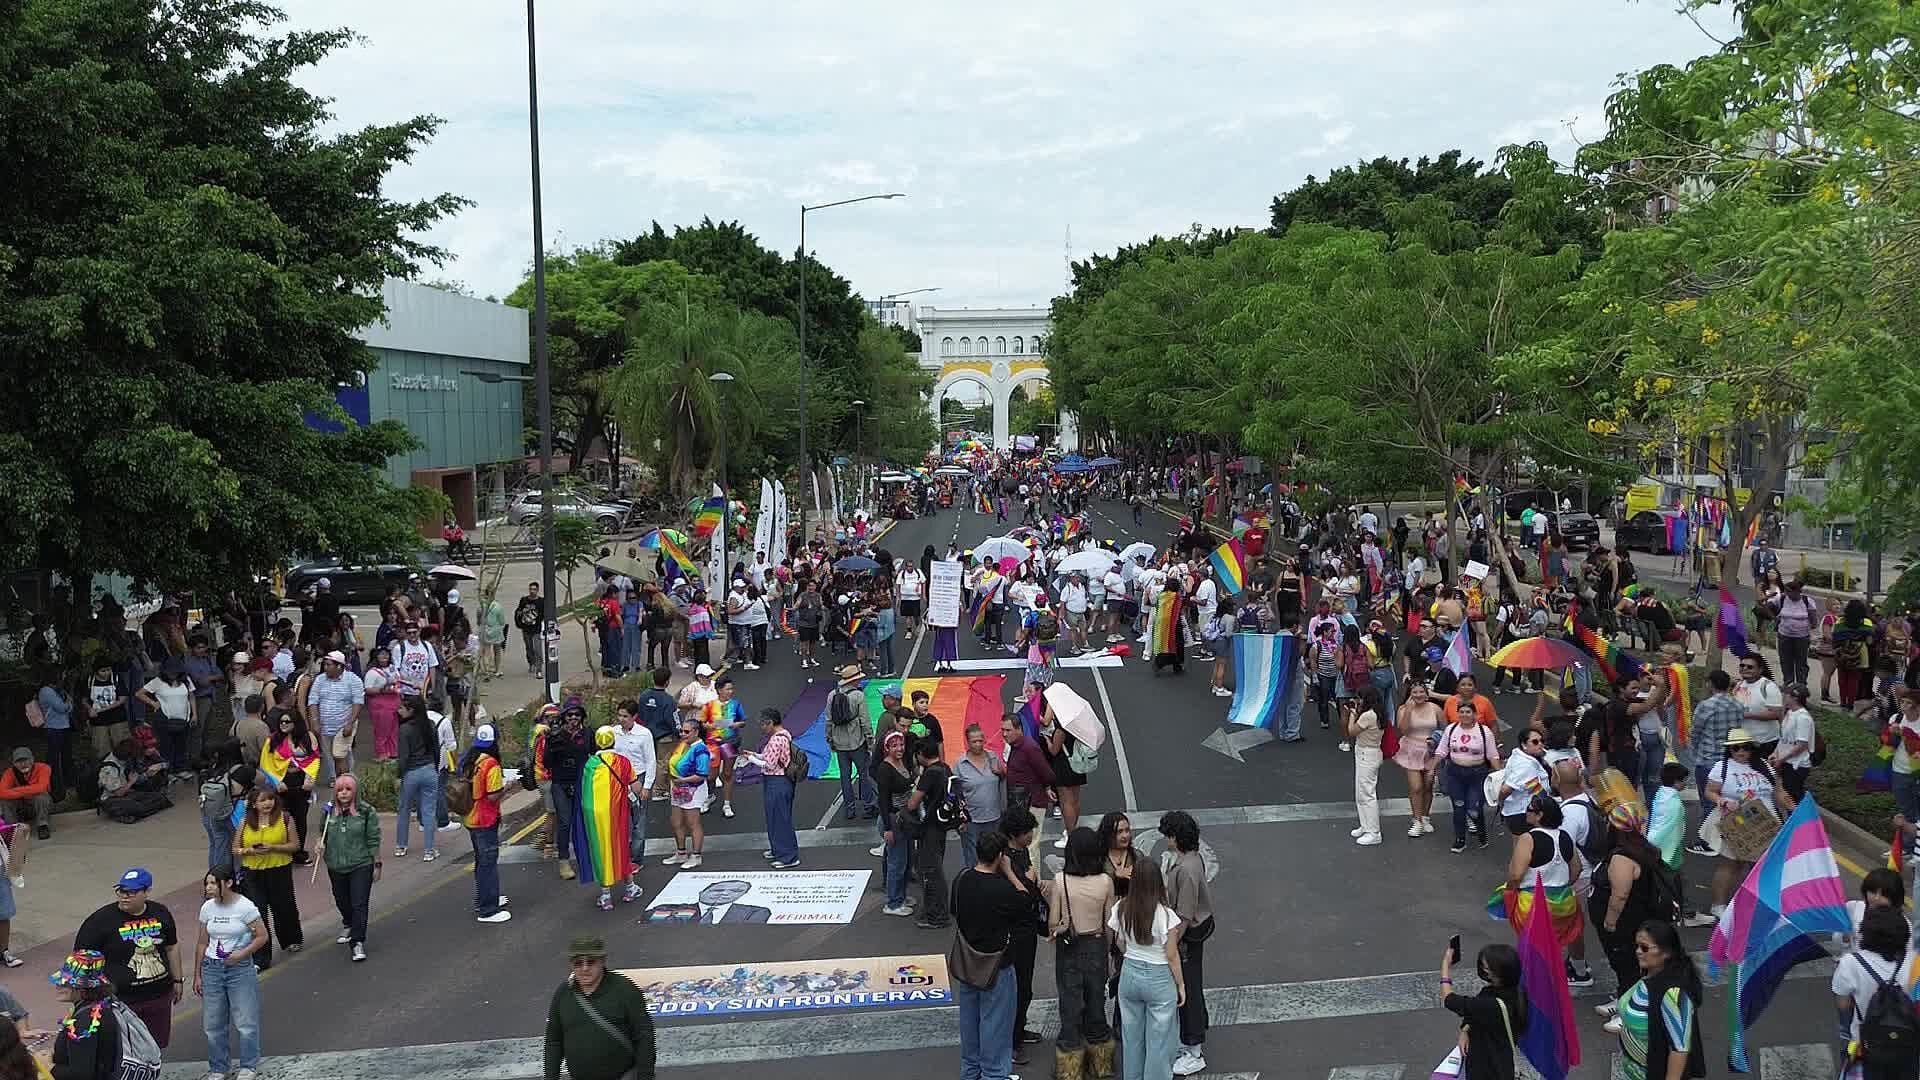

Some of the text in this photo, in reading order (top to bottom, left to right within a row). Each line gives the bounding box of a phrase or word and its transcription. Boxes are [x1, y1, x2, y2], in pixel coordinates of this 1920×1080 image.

[118, 918, 162, 933] STAR
[119, 926, 162, 942] WARS
[889, 975, 934, 986] UDJ
[704, 1000, 721, 1011] Y
[778, 988, 946, 1008] FRONTERAS
